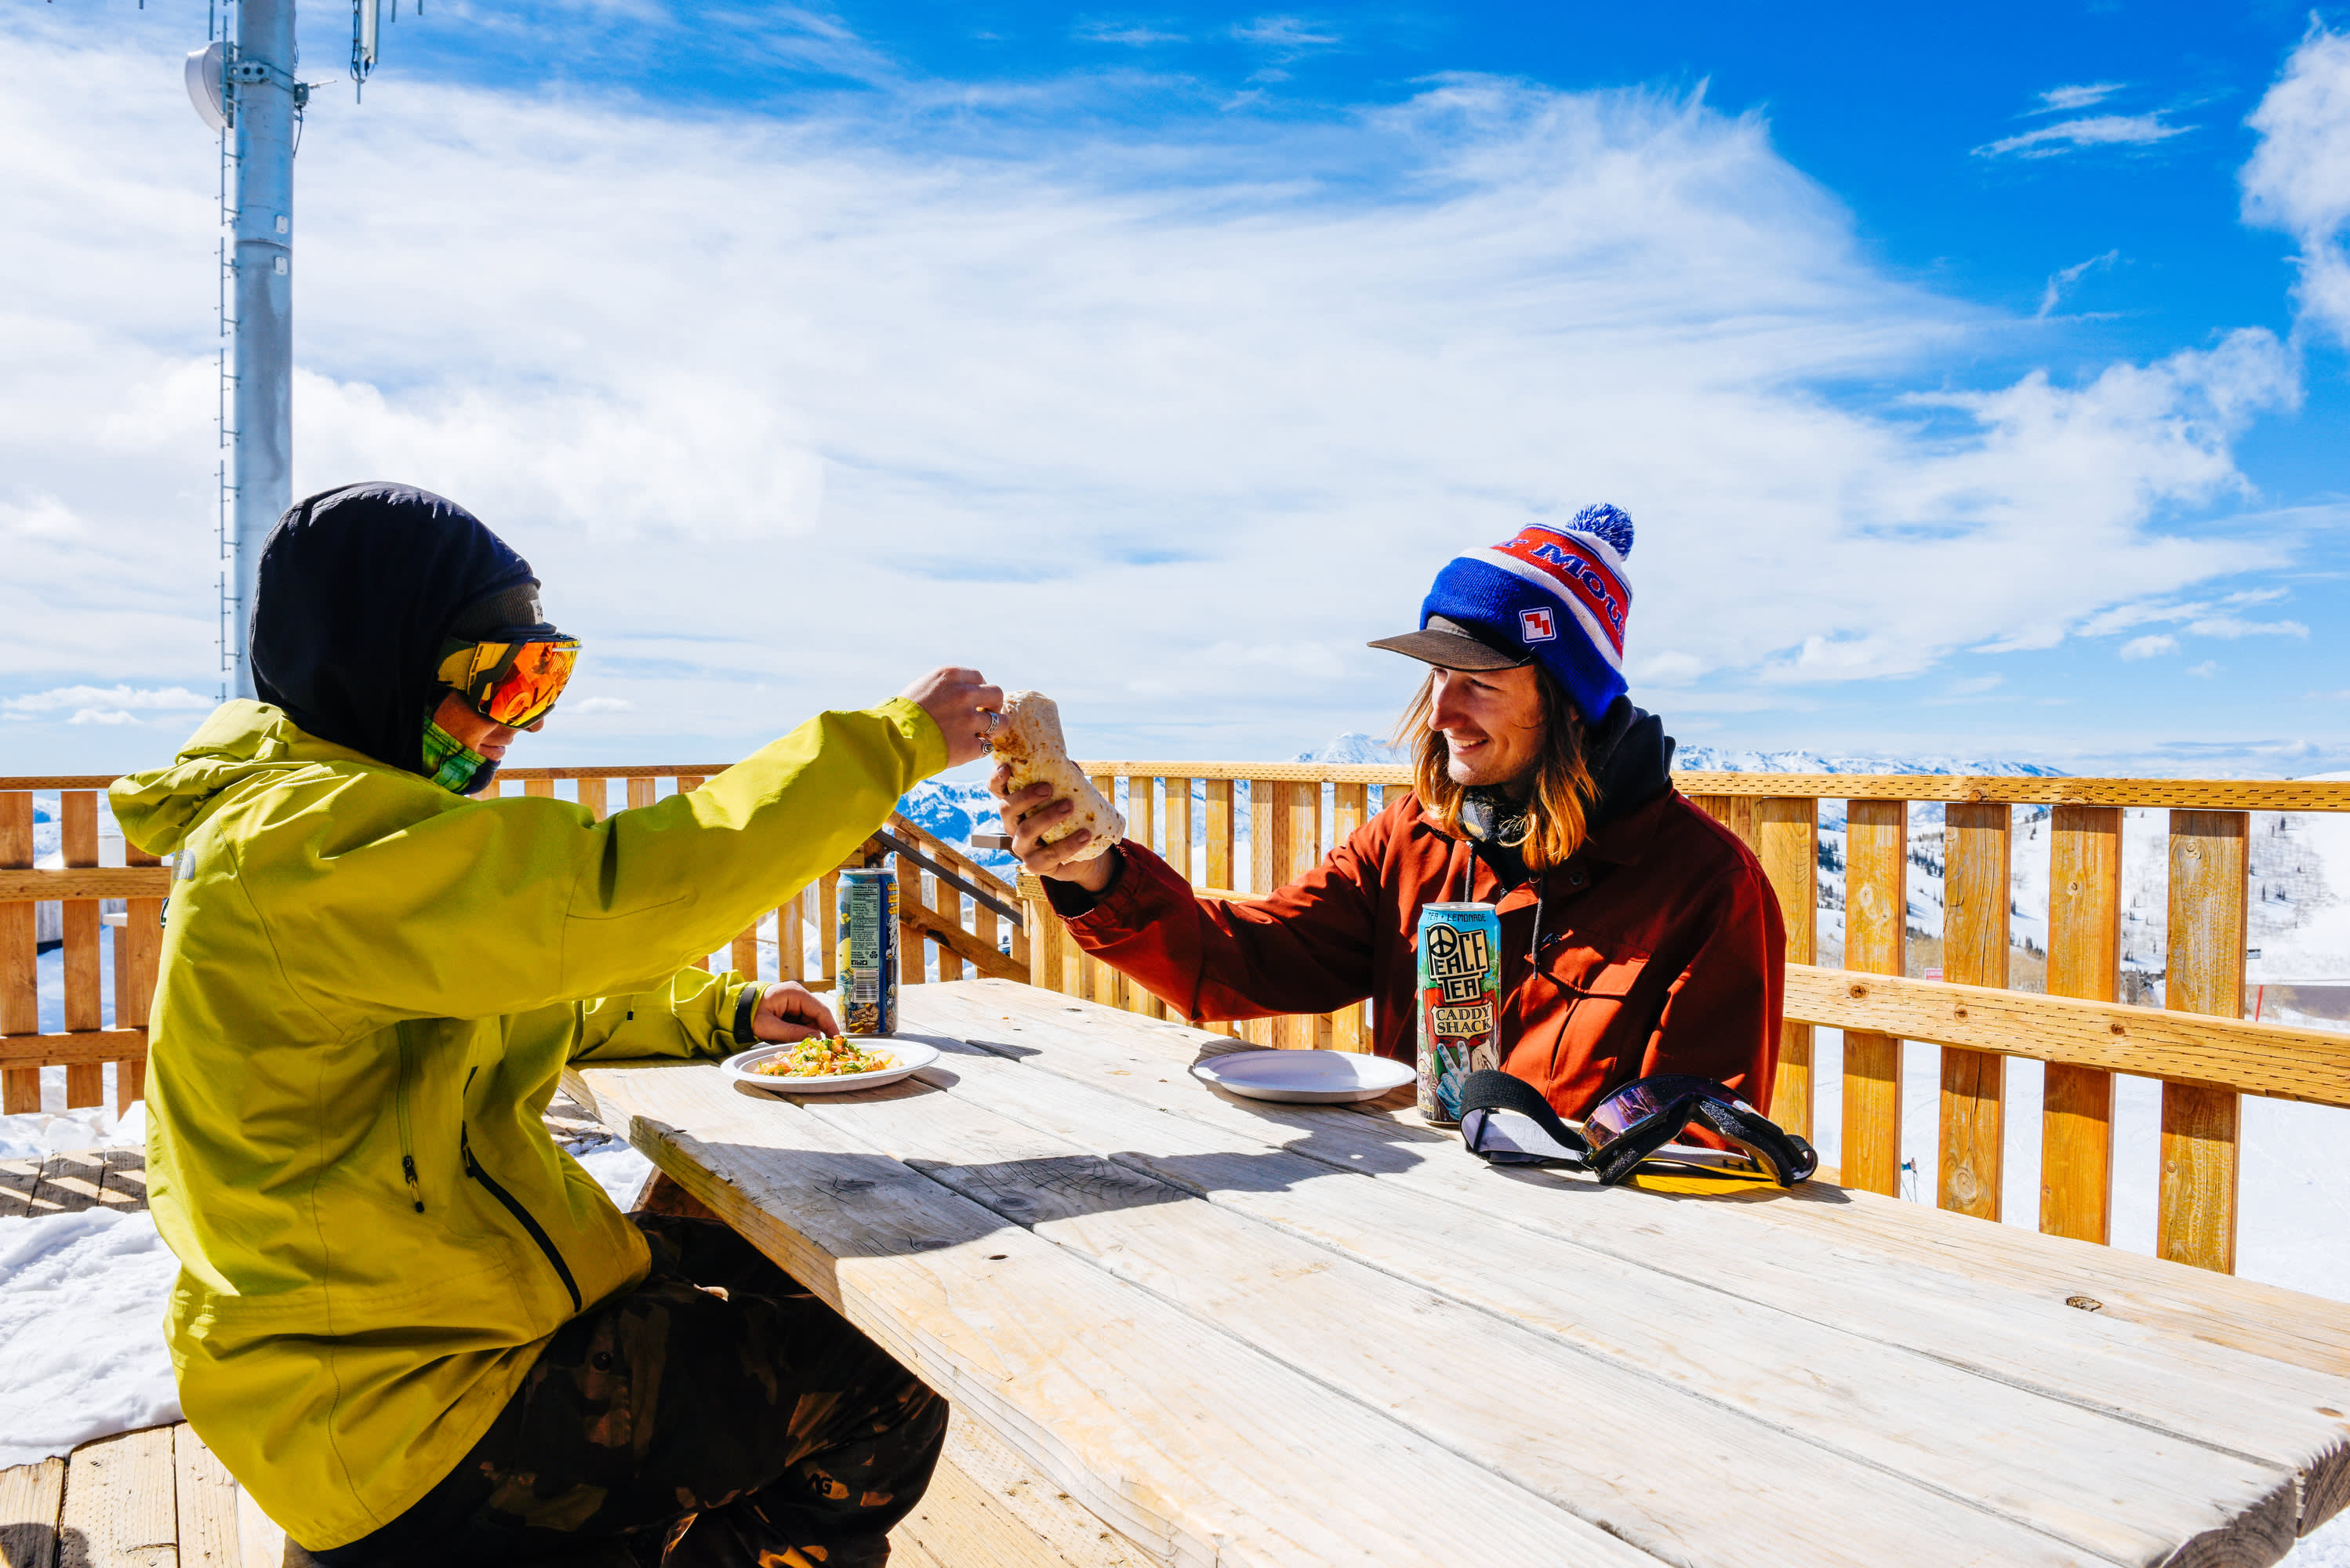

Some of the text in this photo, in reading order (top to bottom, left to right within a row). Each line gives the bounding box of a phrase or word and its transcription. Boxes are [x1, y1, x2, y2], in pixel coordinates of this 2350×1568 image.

[1530, 542, 1625, 645] MOU
[1427, 912, 1439, 921] TEA
[1447, 913, 1487, 923] LEMONADE
[1426, 924, 1487, 976] PEACE
[1438, 973, 1479, 1000] TEA
[1436, 1006, 1490, 1021] CADDY
[1437, 1018, 1491, 1033] SHACK
